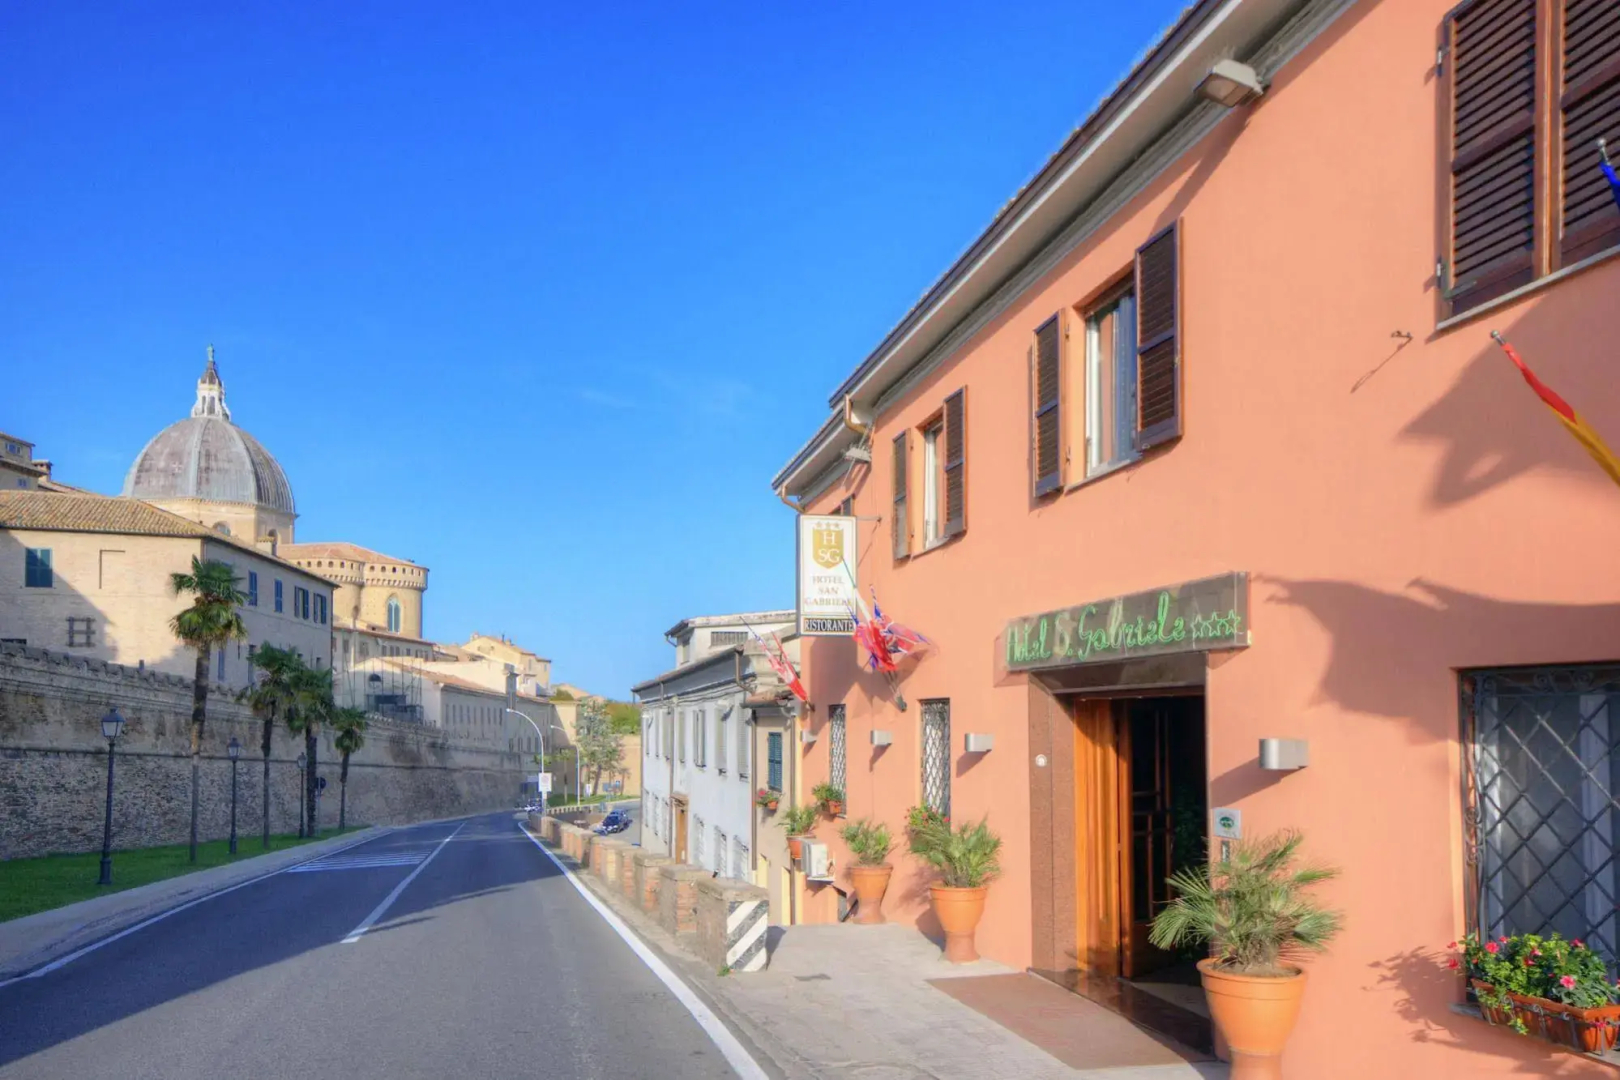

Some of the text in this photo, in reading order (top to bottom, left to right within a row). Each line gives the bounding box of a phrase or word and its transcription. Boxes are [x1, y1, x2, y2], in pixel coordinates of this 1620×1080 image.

[823, 531, 836, 545] H
[818, 548, 840, 563] SG
[811, 575, 844, 584] HOTEL
[818, 587, 838, 595] SAN
[804, 619, 855, 631] RISTORANTE
[1006, 618, 1051, 662] Hotel
[1078, 591, 1186, 661] Gabriele
